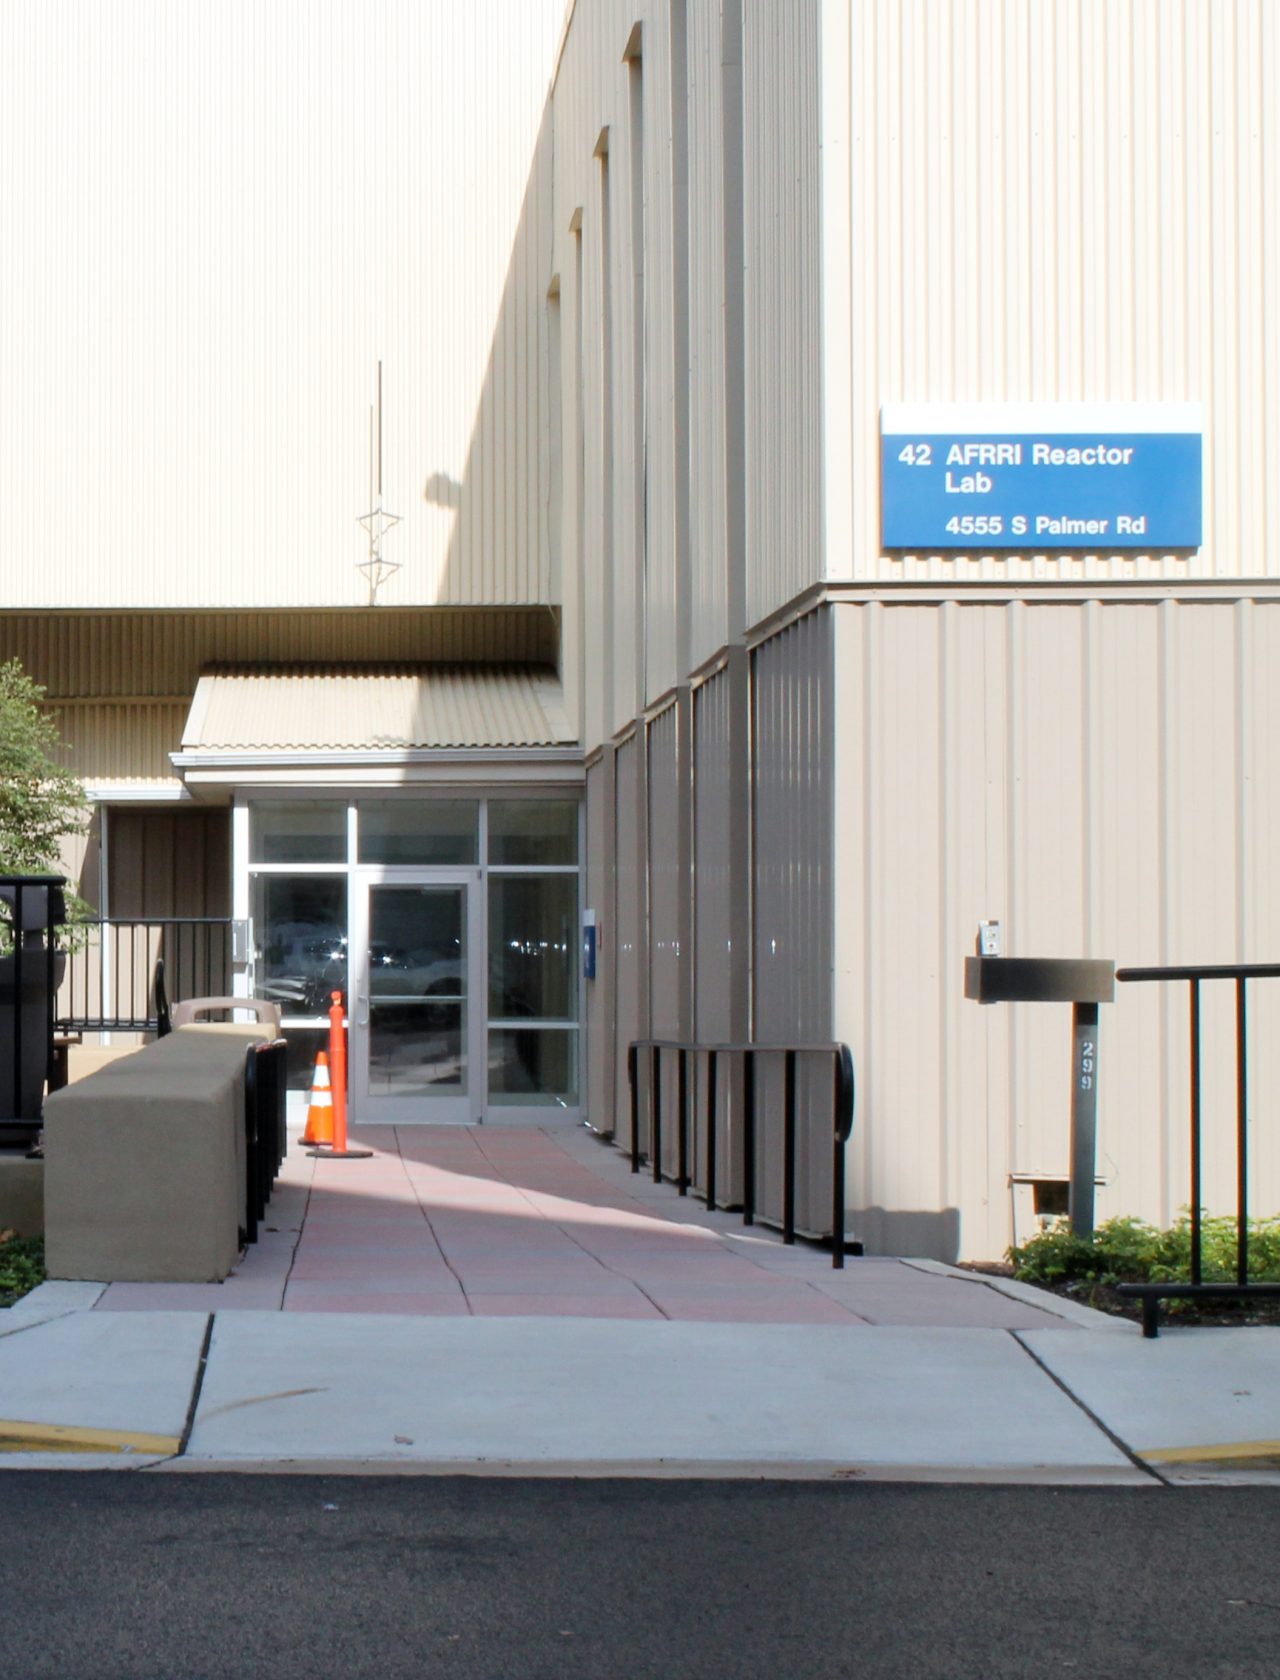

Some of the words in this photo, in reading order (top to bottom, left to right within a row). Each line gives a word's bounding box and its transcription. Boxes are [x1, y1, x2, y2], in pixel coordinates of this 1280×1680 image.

[898, 443, 933, 466] 42
[945, 443, 1022, 466] AFRRI
[1032, 443, 1134, 466] Reactor
[945, 471, 993, 494] Lab
[945, 515, 1003, 535] 4555
[1011, 515, 1028, 535] S
[1035, 515, 1109, 535] Palmer
[1116, 515, 1147, 535] Rd
